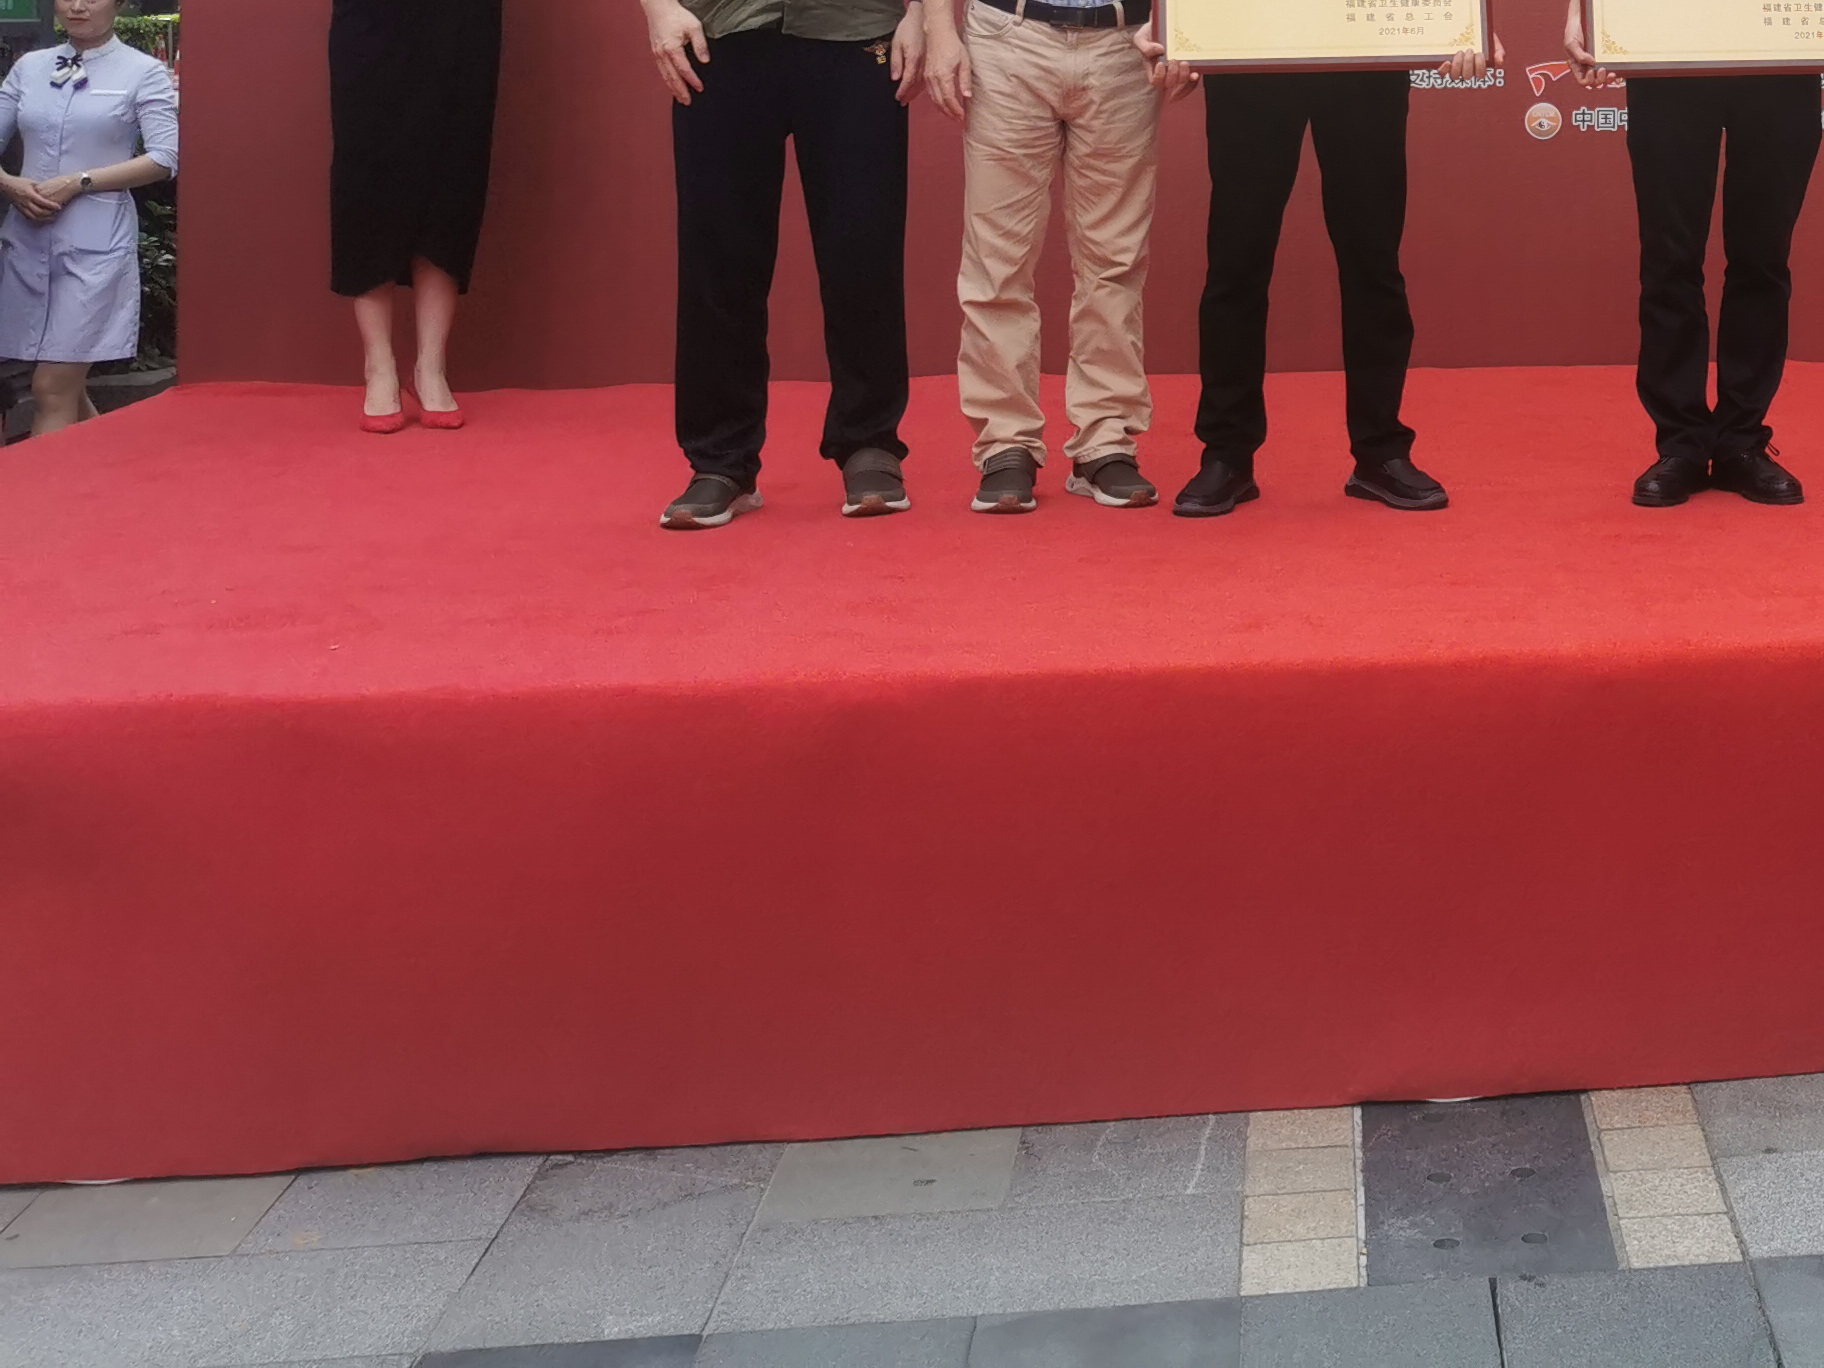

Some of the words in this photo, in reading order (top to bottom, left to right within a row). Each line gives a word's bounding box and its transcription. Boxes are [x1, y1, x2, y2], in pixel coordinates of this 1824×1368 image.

[1345, 11, 1454, 23] 福建省总工会
[1378, 26, 1425, 36] 2021年6月
